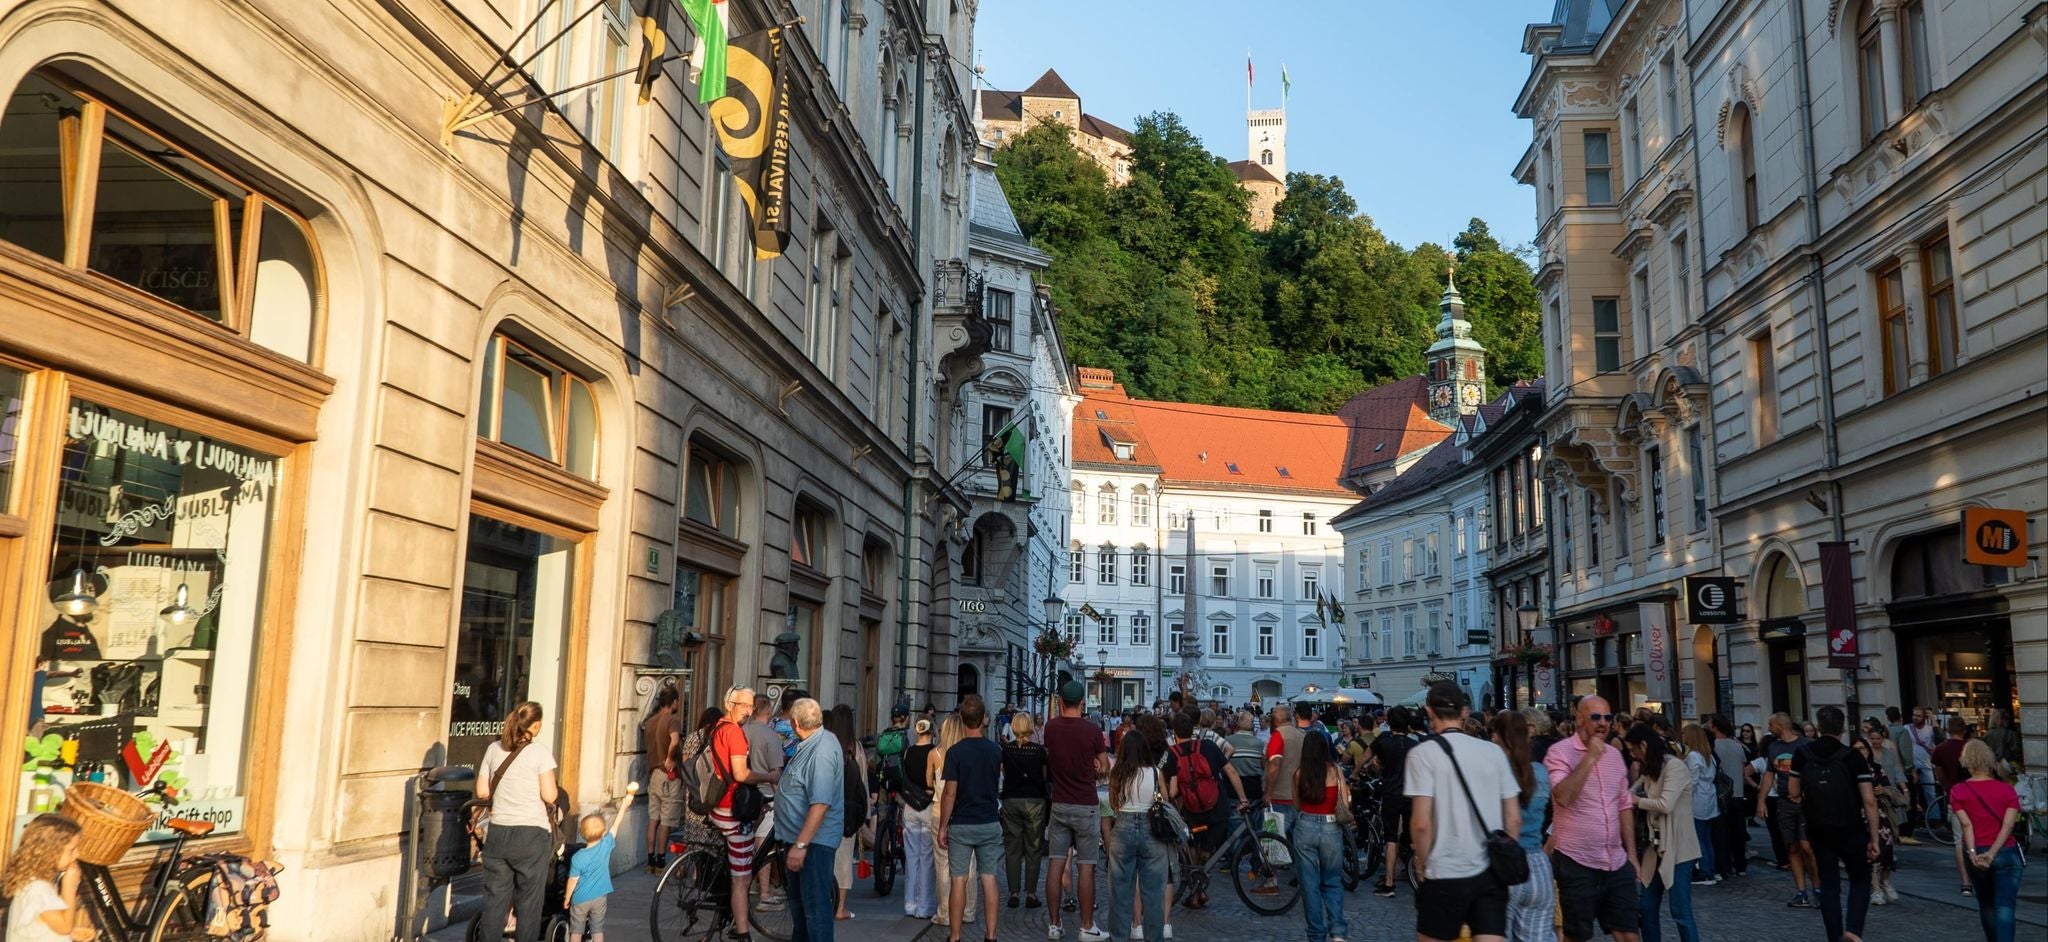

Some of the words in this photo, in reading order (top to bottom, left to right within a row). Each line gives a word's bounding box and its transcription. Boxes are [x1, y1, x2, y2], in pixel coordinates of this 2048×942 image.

[69, 406, 168, 460] LJUBLJANA
[196, 440, 274, 487] LJUBLJANA
[1649, 624, 1665, 683] s.Oliver
[202, 806, 233, 829] shop
